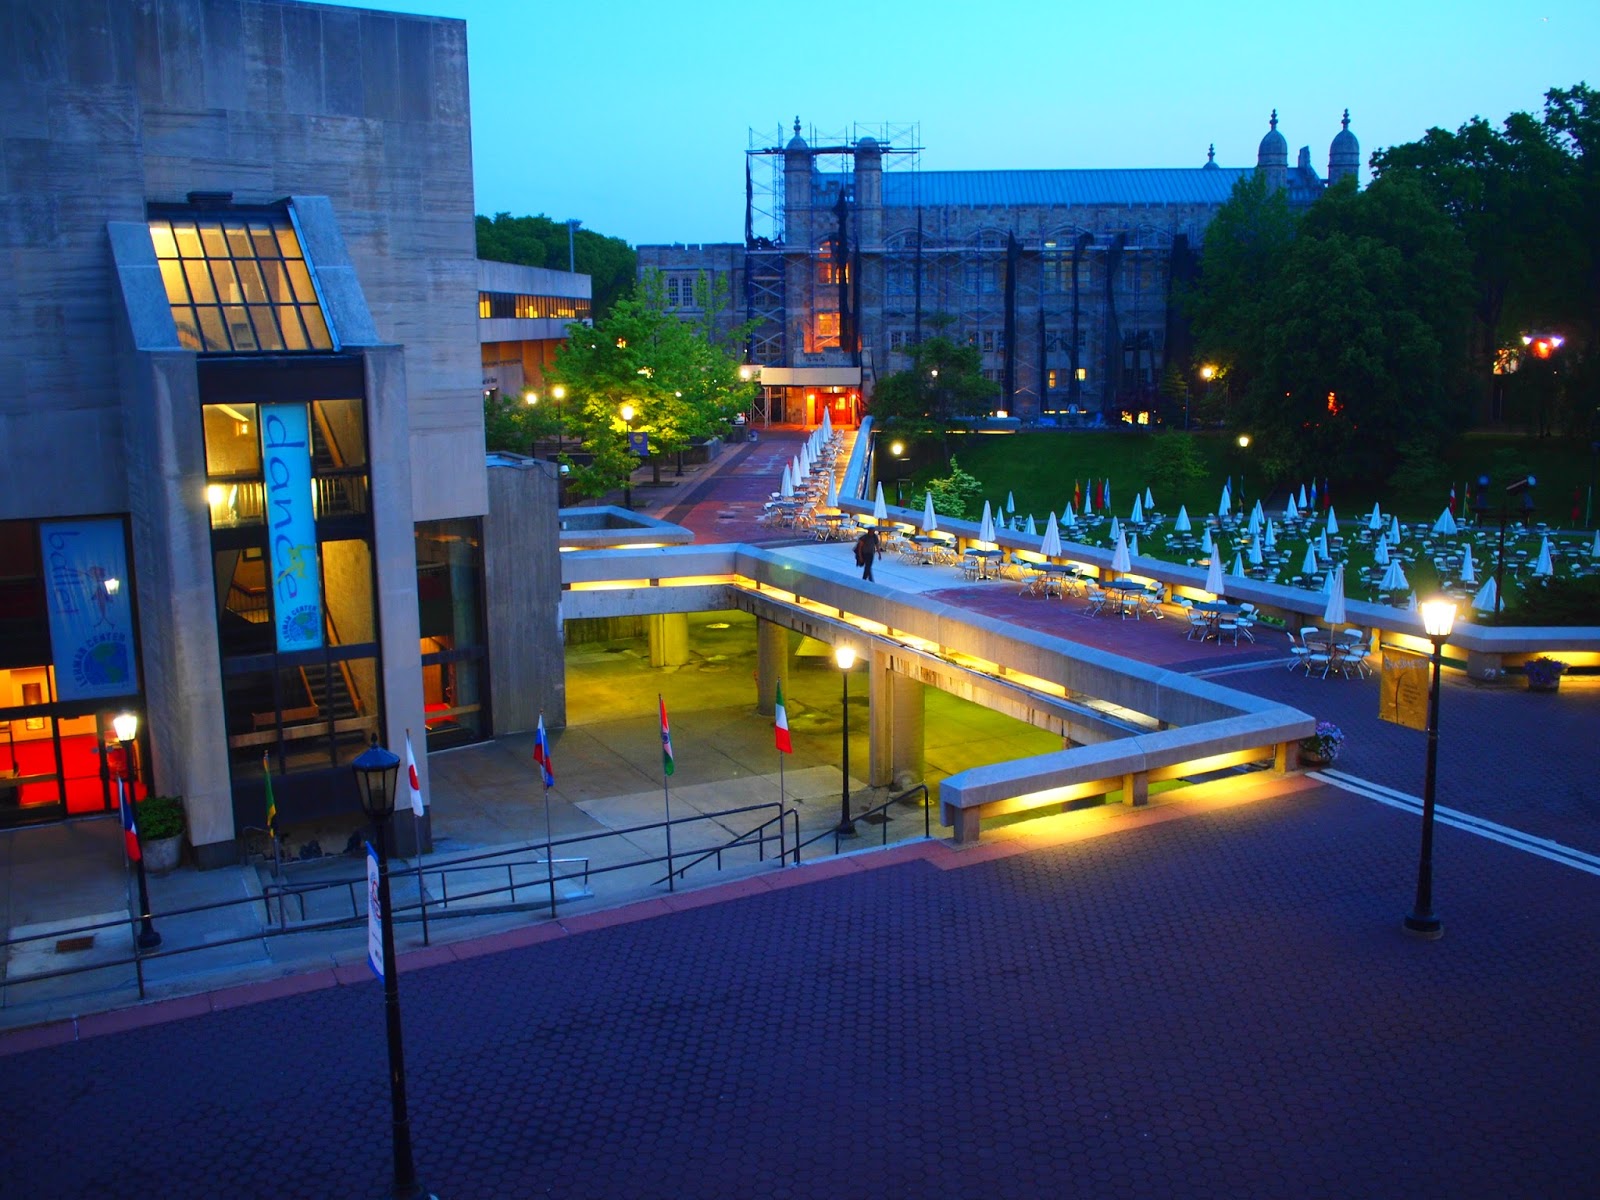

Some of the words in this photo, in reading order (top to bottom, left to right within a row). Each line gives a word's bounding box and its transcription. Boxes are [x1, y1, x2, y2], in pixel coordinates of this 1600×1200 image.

[265, 414, 306, 605] dance
[48, 530, 81, 615] ballet
[291, 604, 317, 616] CENTER
[72, 646, 90, 688] LEHMAN
[86, 631, 126, 648] CENTER
